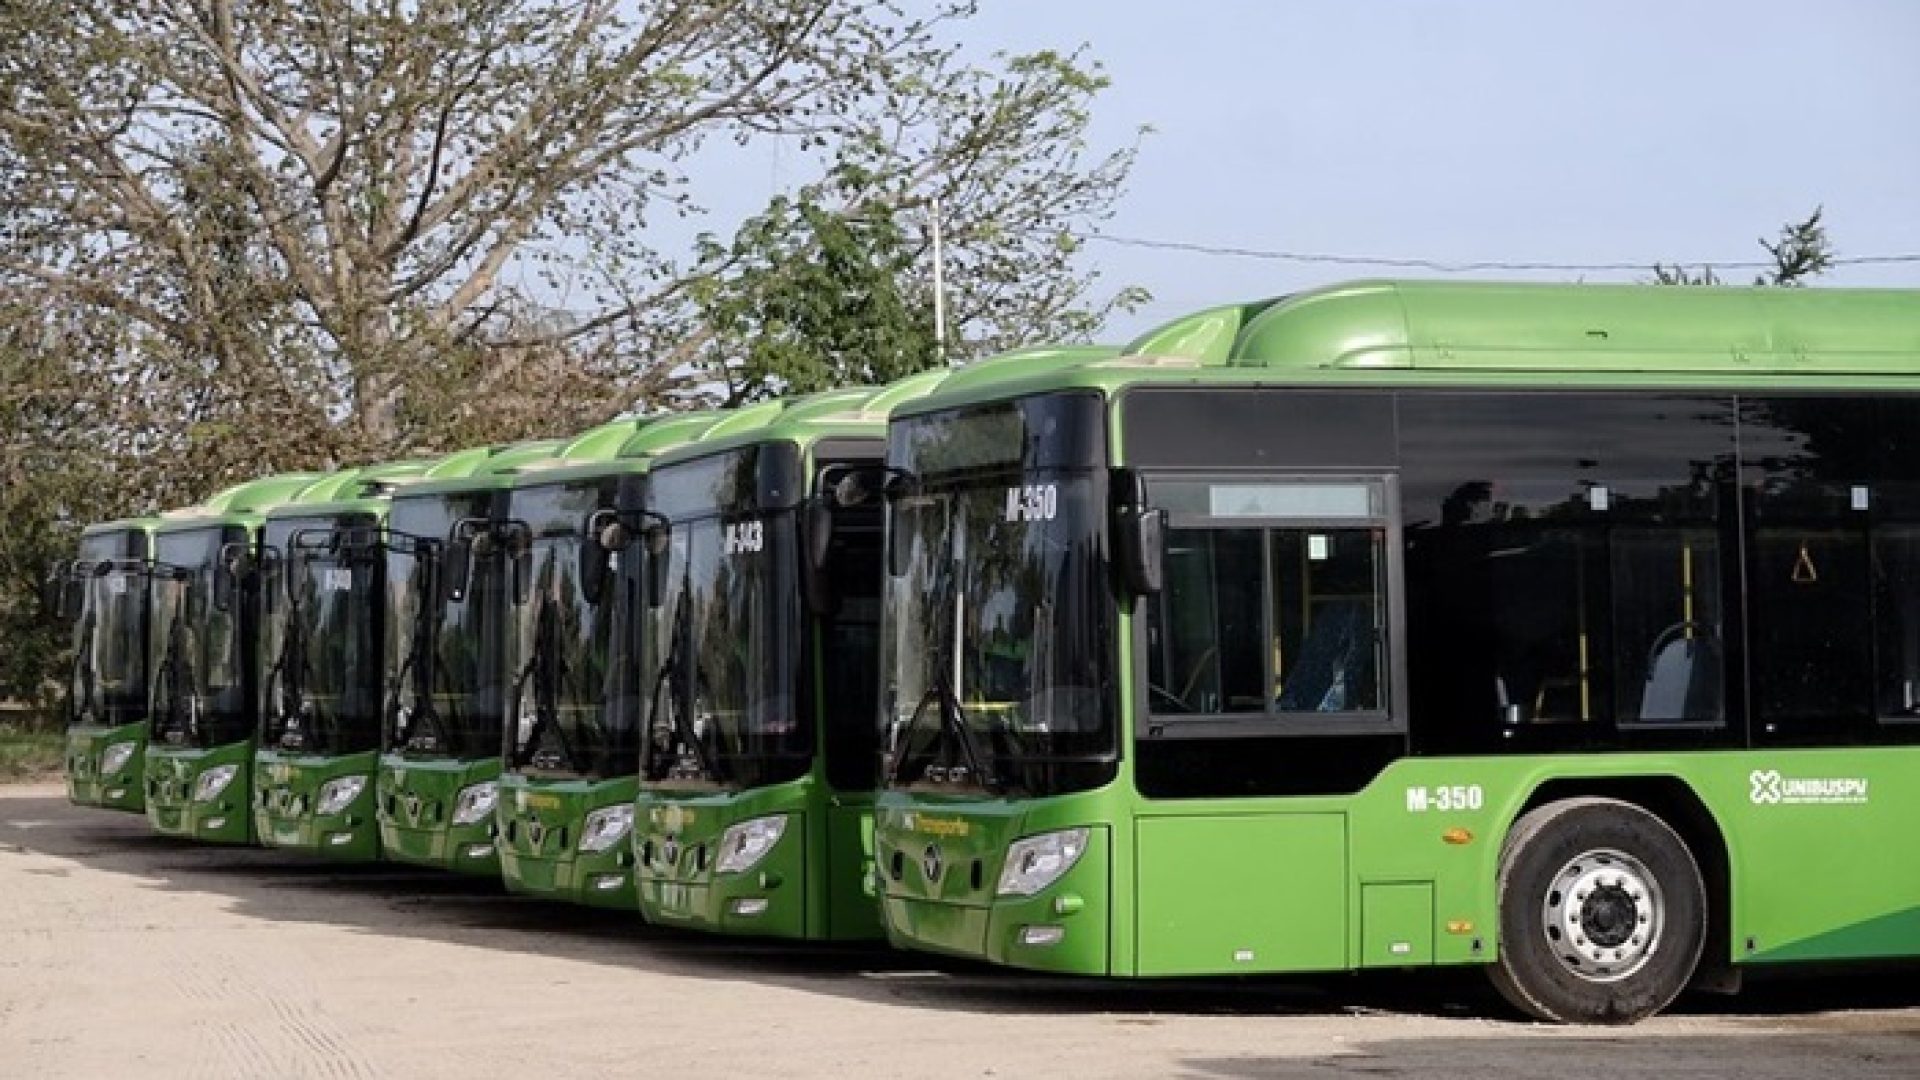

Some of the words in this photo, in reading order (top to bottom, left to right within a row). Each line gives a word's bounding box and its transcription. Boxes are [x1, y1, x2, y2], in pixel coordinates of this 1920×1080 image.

[1005, 485, 1056, 521] M-350
[1406, 785, 1482, 811] M-350
[1782, 778, 1868, 796] UNIBUSPV
